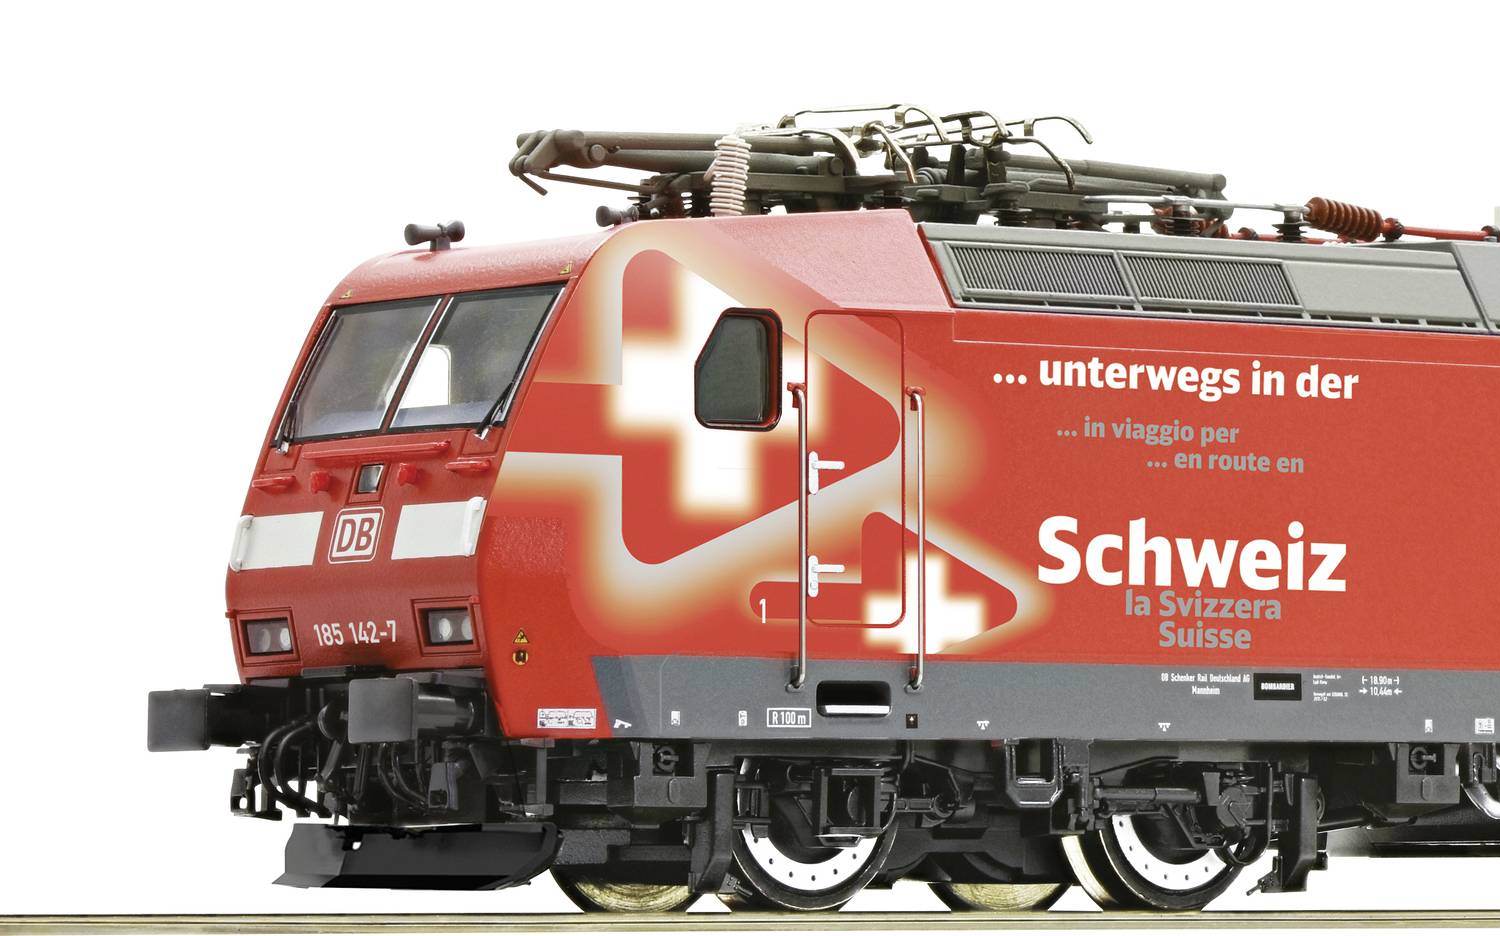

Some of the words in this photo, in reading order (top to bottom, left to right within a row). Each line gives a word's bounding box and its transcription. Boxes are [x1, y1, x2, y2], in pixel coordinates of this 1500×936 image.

[1039, 357, 1241, 402] unterwegs
[1251, 361, 1285, 397] in
[1296, 364, 1360, 400] der
[1084, 416, 1105, 438] in
[1112, 420, 1194, 446] viaggio
[1200, 426, 1240, 448] per
[1174, 451, 1202, 470] en
[1208, 453, 1270, 473] route
[1276, 456, 1305, 474] en
[335, 518, 374, 555] DB
[1037, 515, 1348, 593] Schweiz
[759, 598, 768, 624] 1
[1124, 589, 1151, 617] la
[1158, 590, 1282, 621] Svizzera
[313, 622, 344, 647] 185
[348, 619, 398, 644] 142-7
[1158, 620, 1252, 650] Suisse
[1170, 673, 1195, 682] Schenker
[1197, 673, 1208, 682] Rail
[1209, 673, 1241, 683] Deutschland
[1243, 674, 1250, 683] AG
[1191, 685, 1221, 695] Mannheim
[772, 711, 779, 725] R
[780, 711, 796, 725] 100
[797, 715, 806, 725] m
